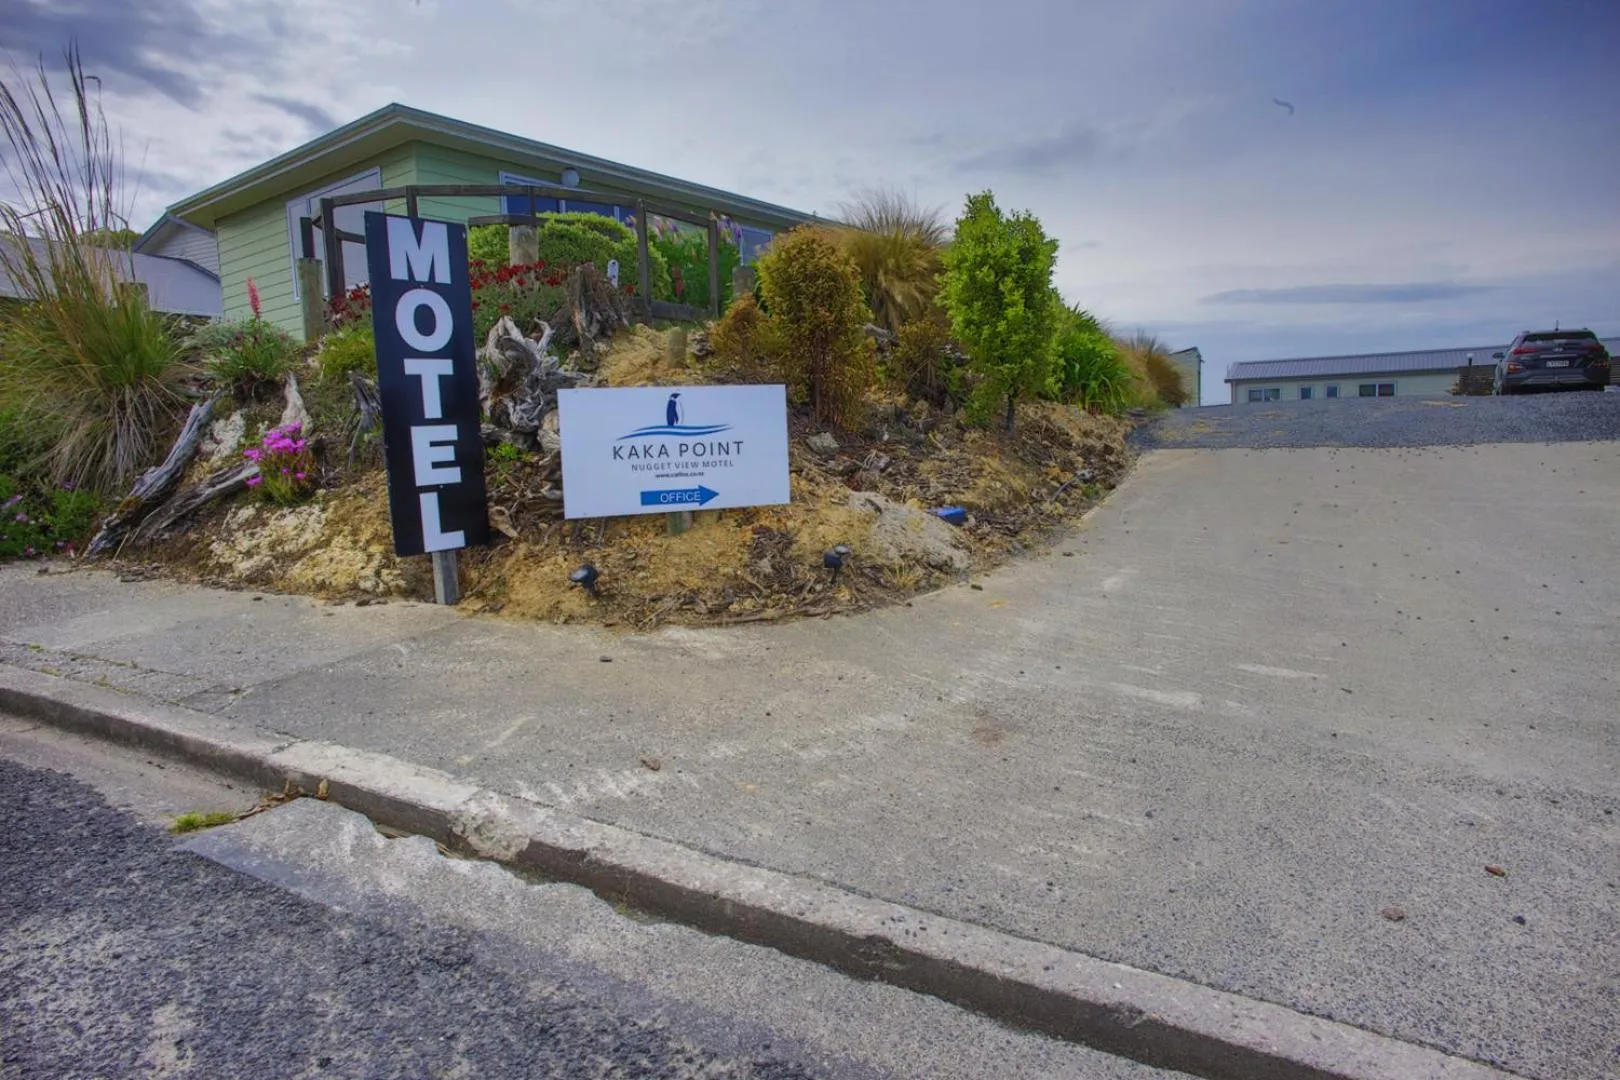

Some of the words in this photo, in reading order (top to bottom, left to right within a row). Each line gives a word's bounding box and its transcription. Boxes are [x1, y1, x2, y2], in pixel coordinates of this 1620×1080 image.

[386, 216, 466, 553] MOTEL
[612, 444, 669, 460] KAKA
[679, 441, 744, 456] POINT
[631, 463, 671, 472] NUGGET
[674, 461, 699, 470] VIEW
[702, 459, 734, 469] MOTEL
[660, 490, 701, 503] OFFICE
